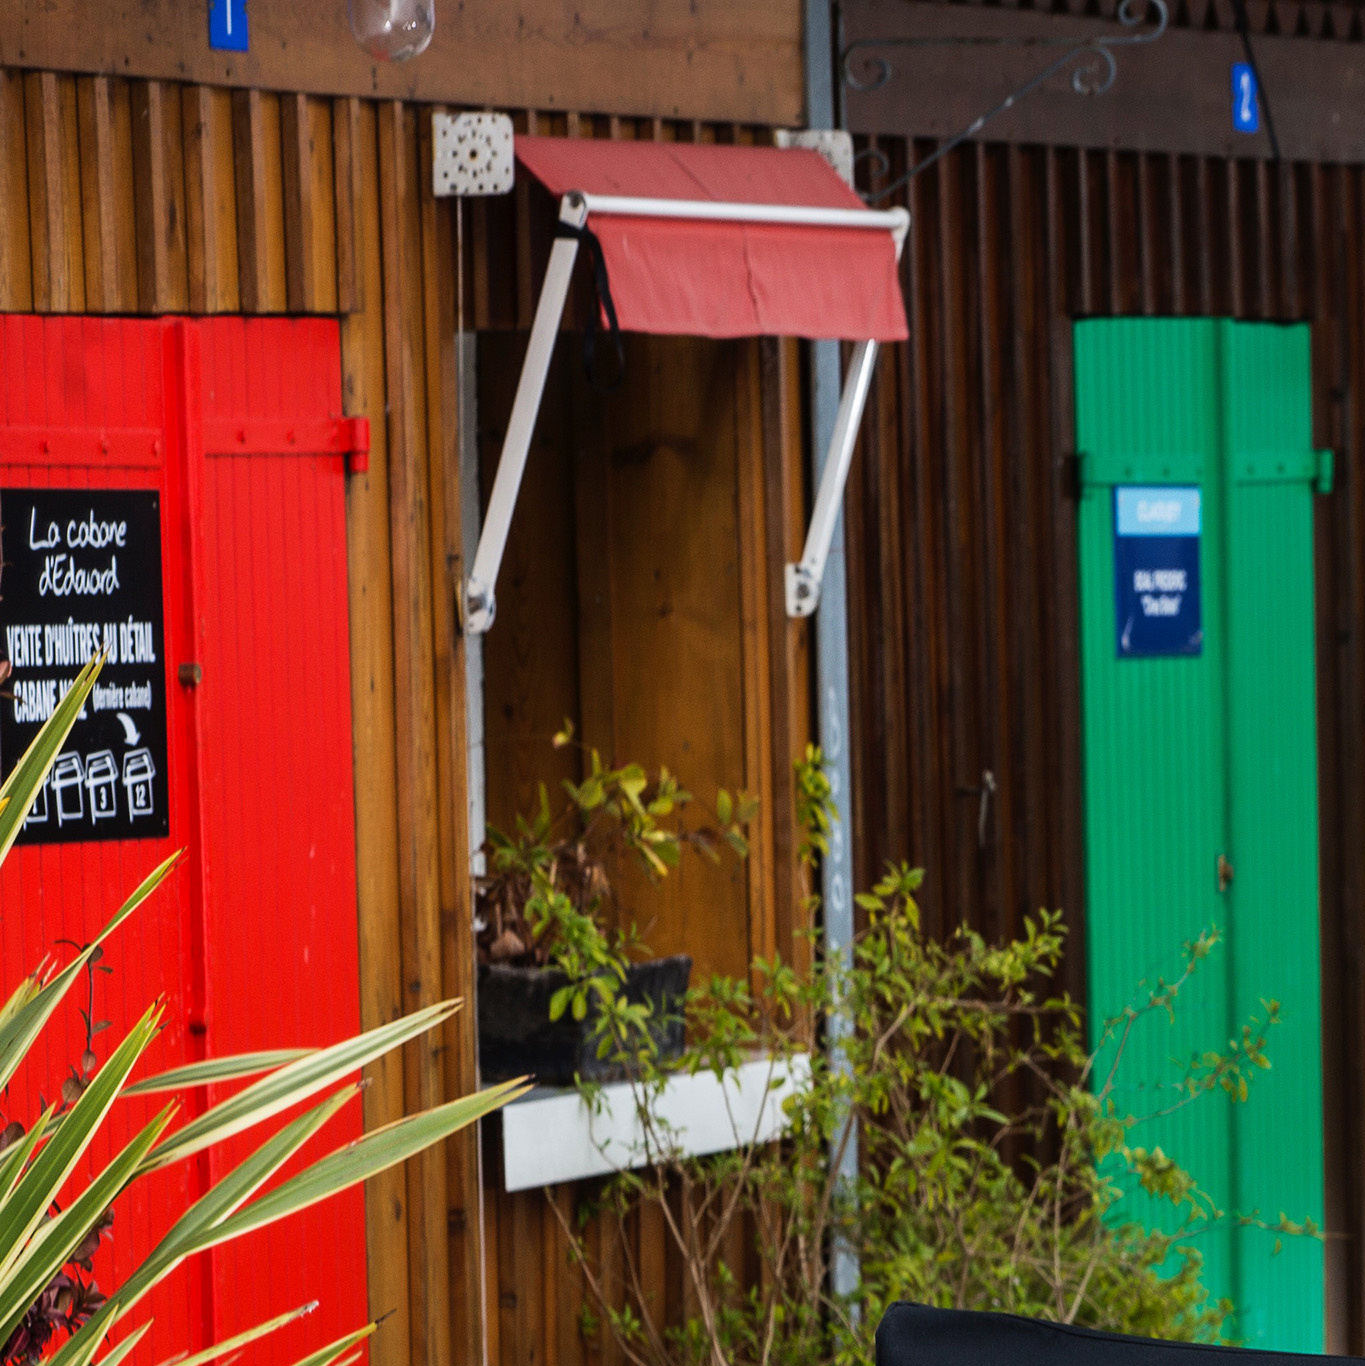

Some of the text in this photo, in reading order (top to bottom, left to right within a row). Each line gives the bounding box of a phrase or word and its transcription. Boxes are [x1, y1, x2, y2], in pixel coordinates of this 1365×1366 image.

[29, 505, 127, 551] La cabane
[6, 613, 156, 667] VENTE D'HUÎTRES AU DÉTAIL
[100, 786, 107, 810] 3
[135, 783, 146, 808] 12
